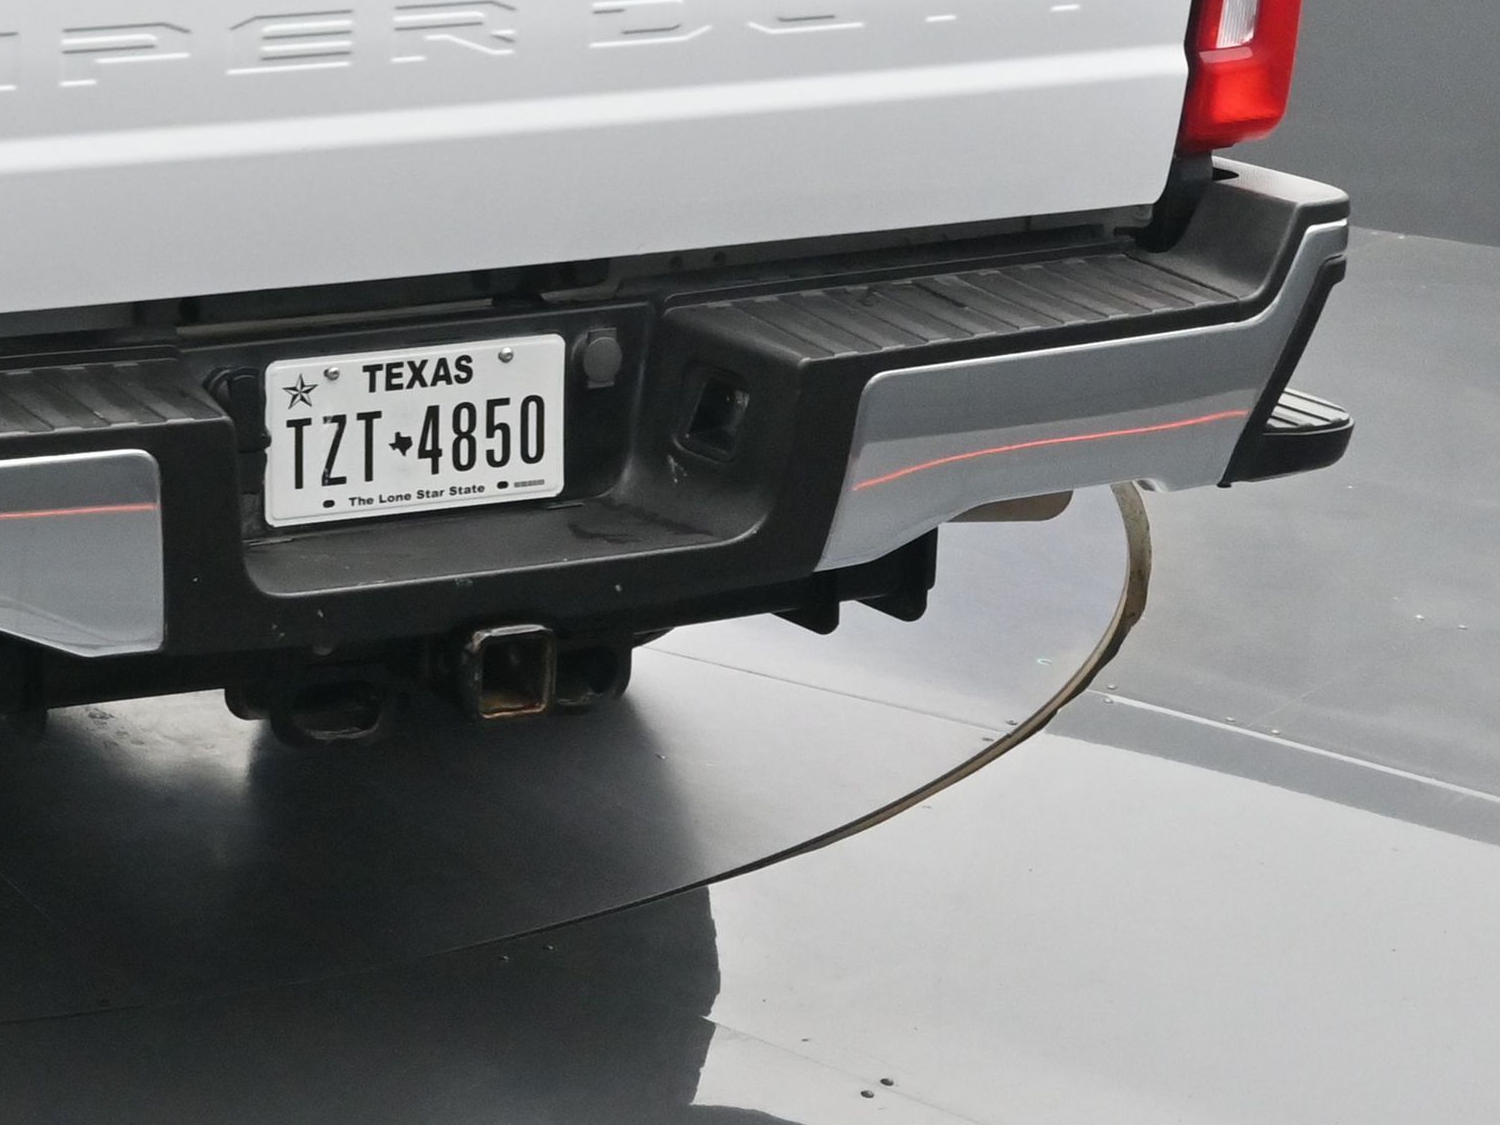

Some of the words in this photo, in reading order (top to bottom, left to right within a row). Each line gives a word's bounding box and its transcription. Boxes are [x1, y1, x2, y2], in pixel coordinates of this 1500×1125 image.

[362, 354, 474, 394] TEXAS
[286, 410, 382, 490] TZT
[417, 394, 546, 476] 4850
[348, 496, 375, 507] The
[379, 492, 412, 504] Lone
[416, 488, 445, 500] Star
[449, 484, 485, 496] State
